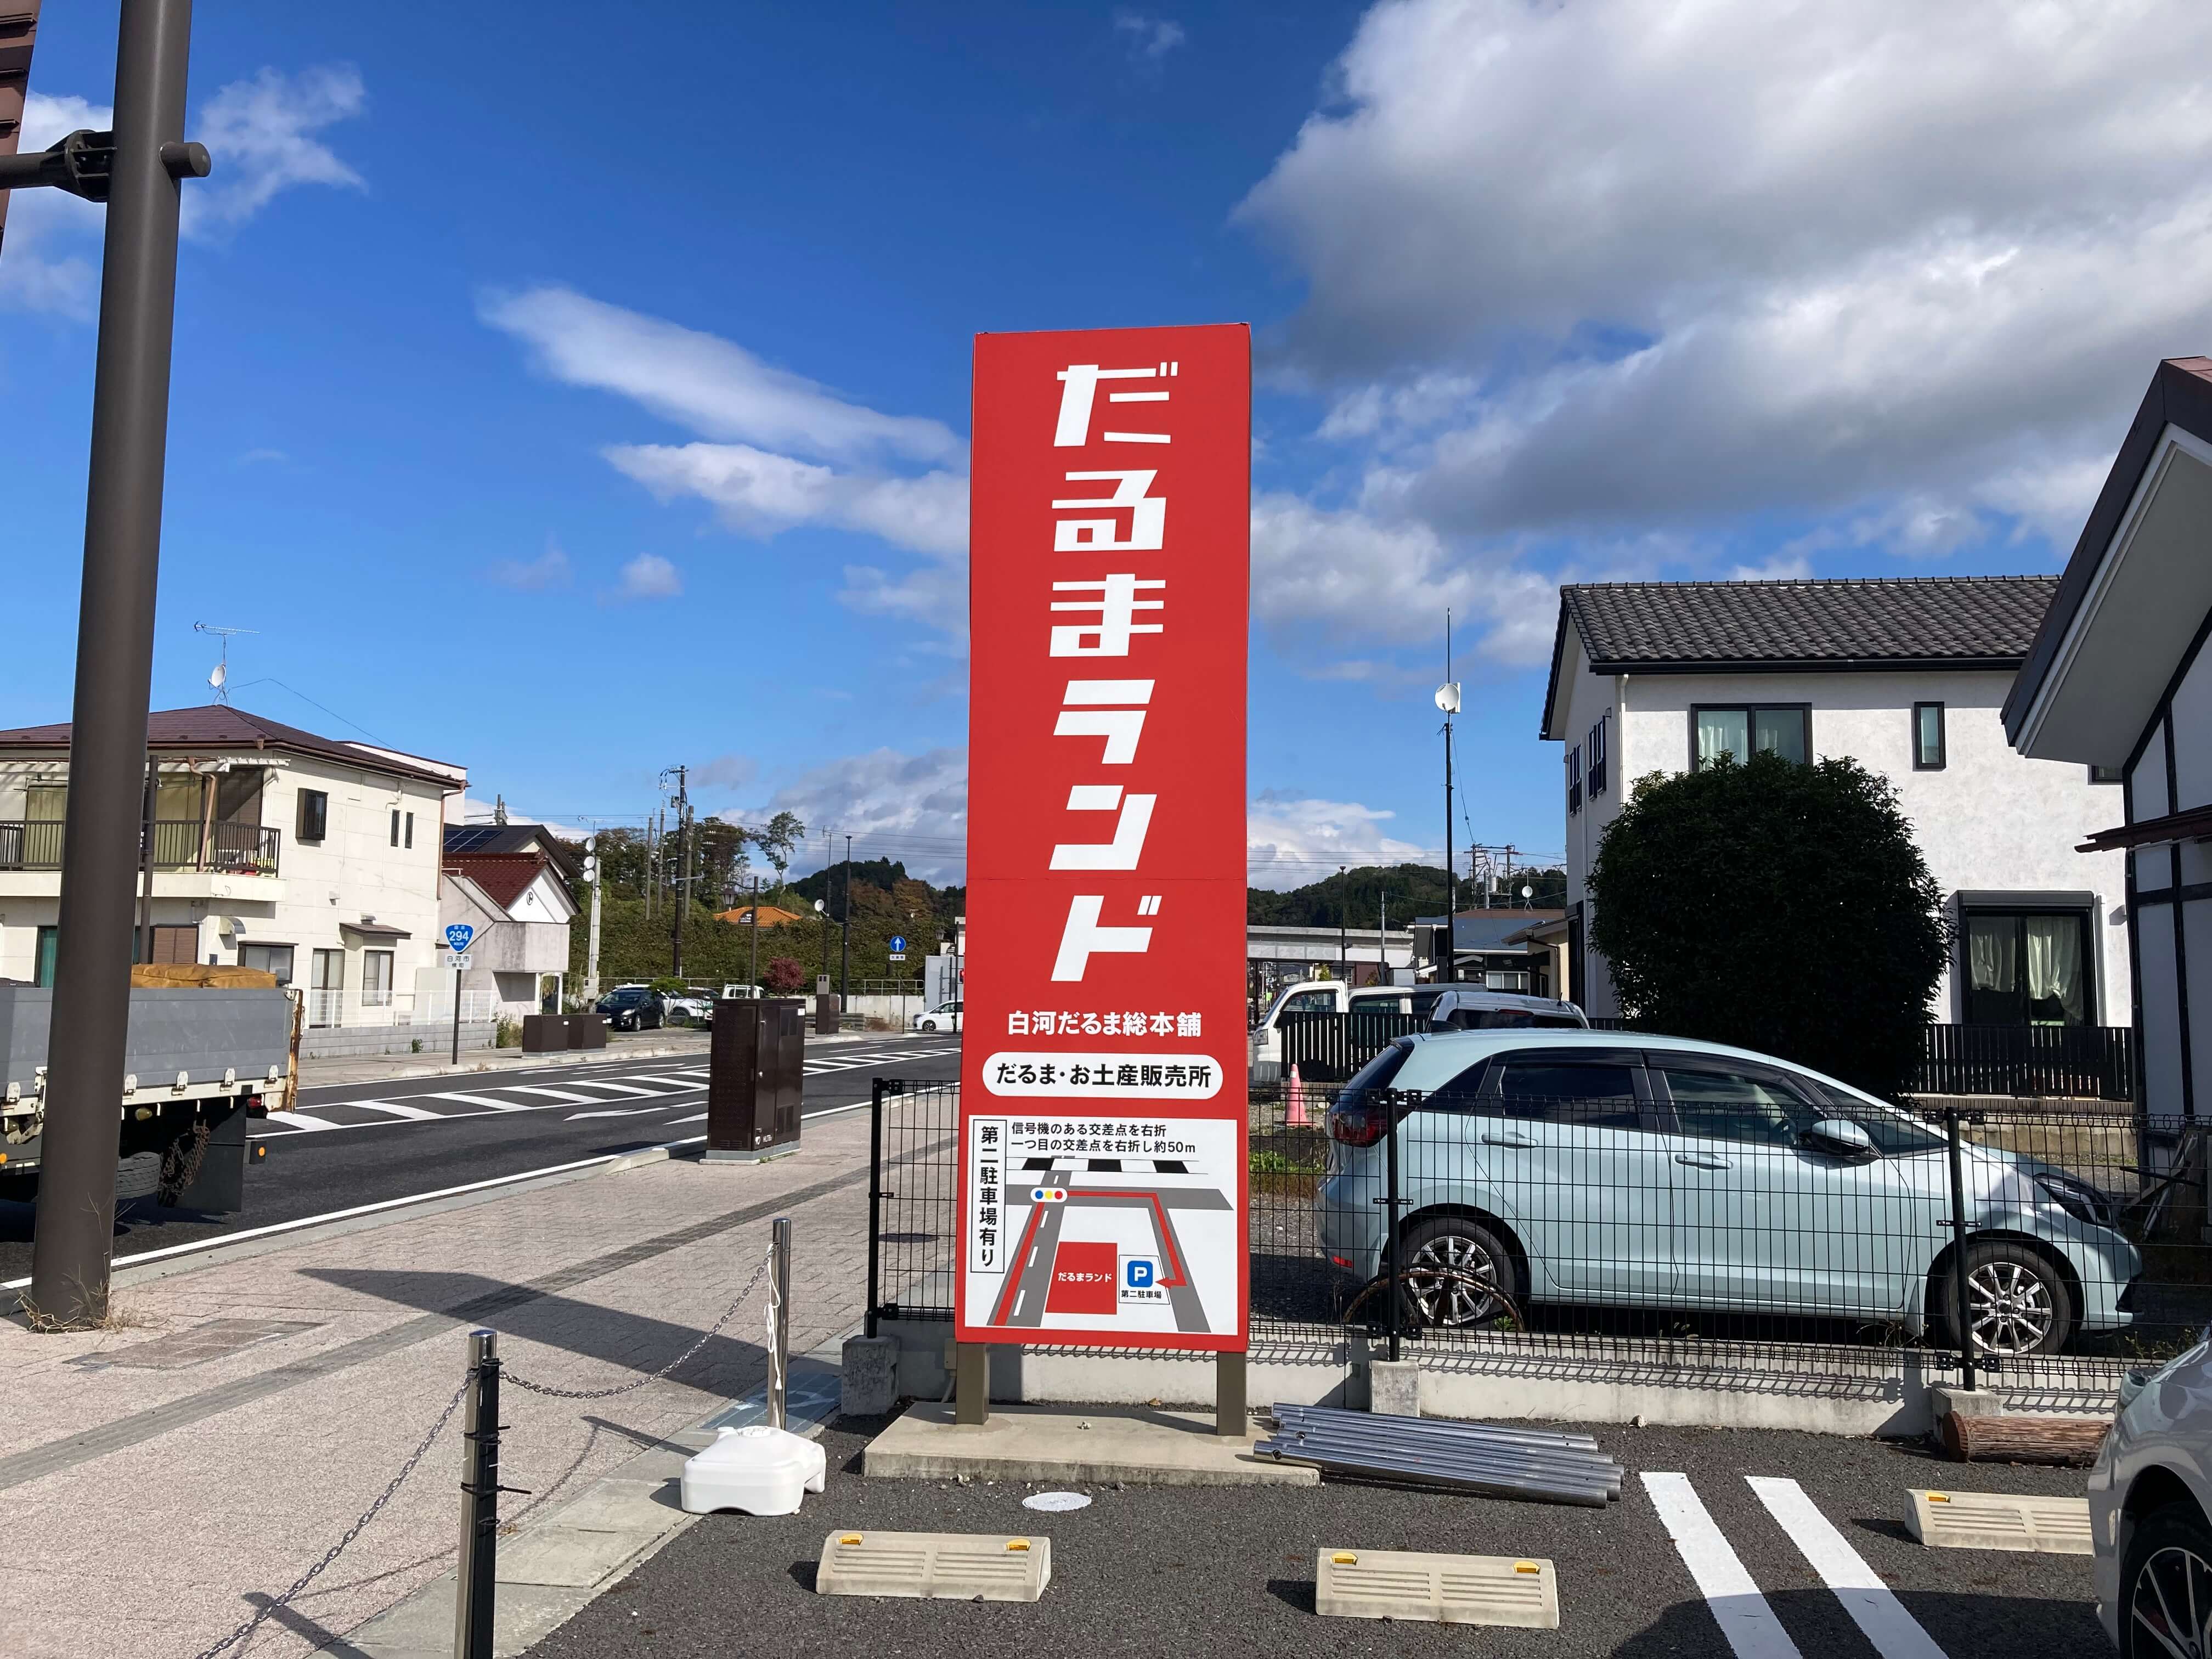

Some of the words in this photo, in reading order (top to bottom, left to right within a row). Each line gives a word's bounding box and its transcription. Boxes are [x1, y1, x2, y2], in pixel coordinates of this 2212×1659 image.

[1049, 362, 1178, 981] だるまランド
[449, 930, 469, 941] 294
[1008, 1010, 1201, 1037] 白河だるま総本舗
[997, 1063, 1211, 1088] だるま・お土産販売所
[1012, 1122, 1166, 1137] 信号機のある交差点を右折
[1011, 1138, 1195, 1153] 一つ目の交差点を右折し約50m
[979, 1126, 998, 1267] 第二駐車場有り
[1058, 1271, 1112, 1283] だるまランド
[1134, 1266, 1148, 1282] P
[1121, 1290, 1161, 1299] 第二駐車場
